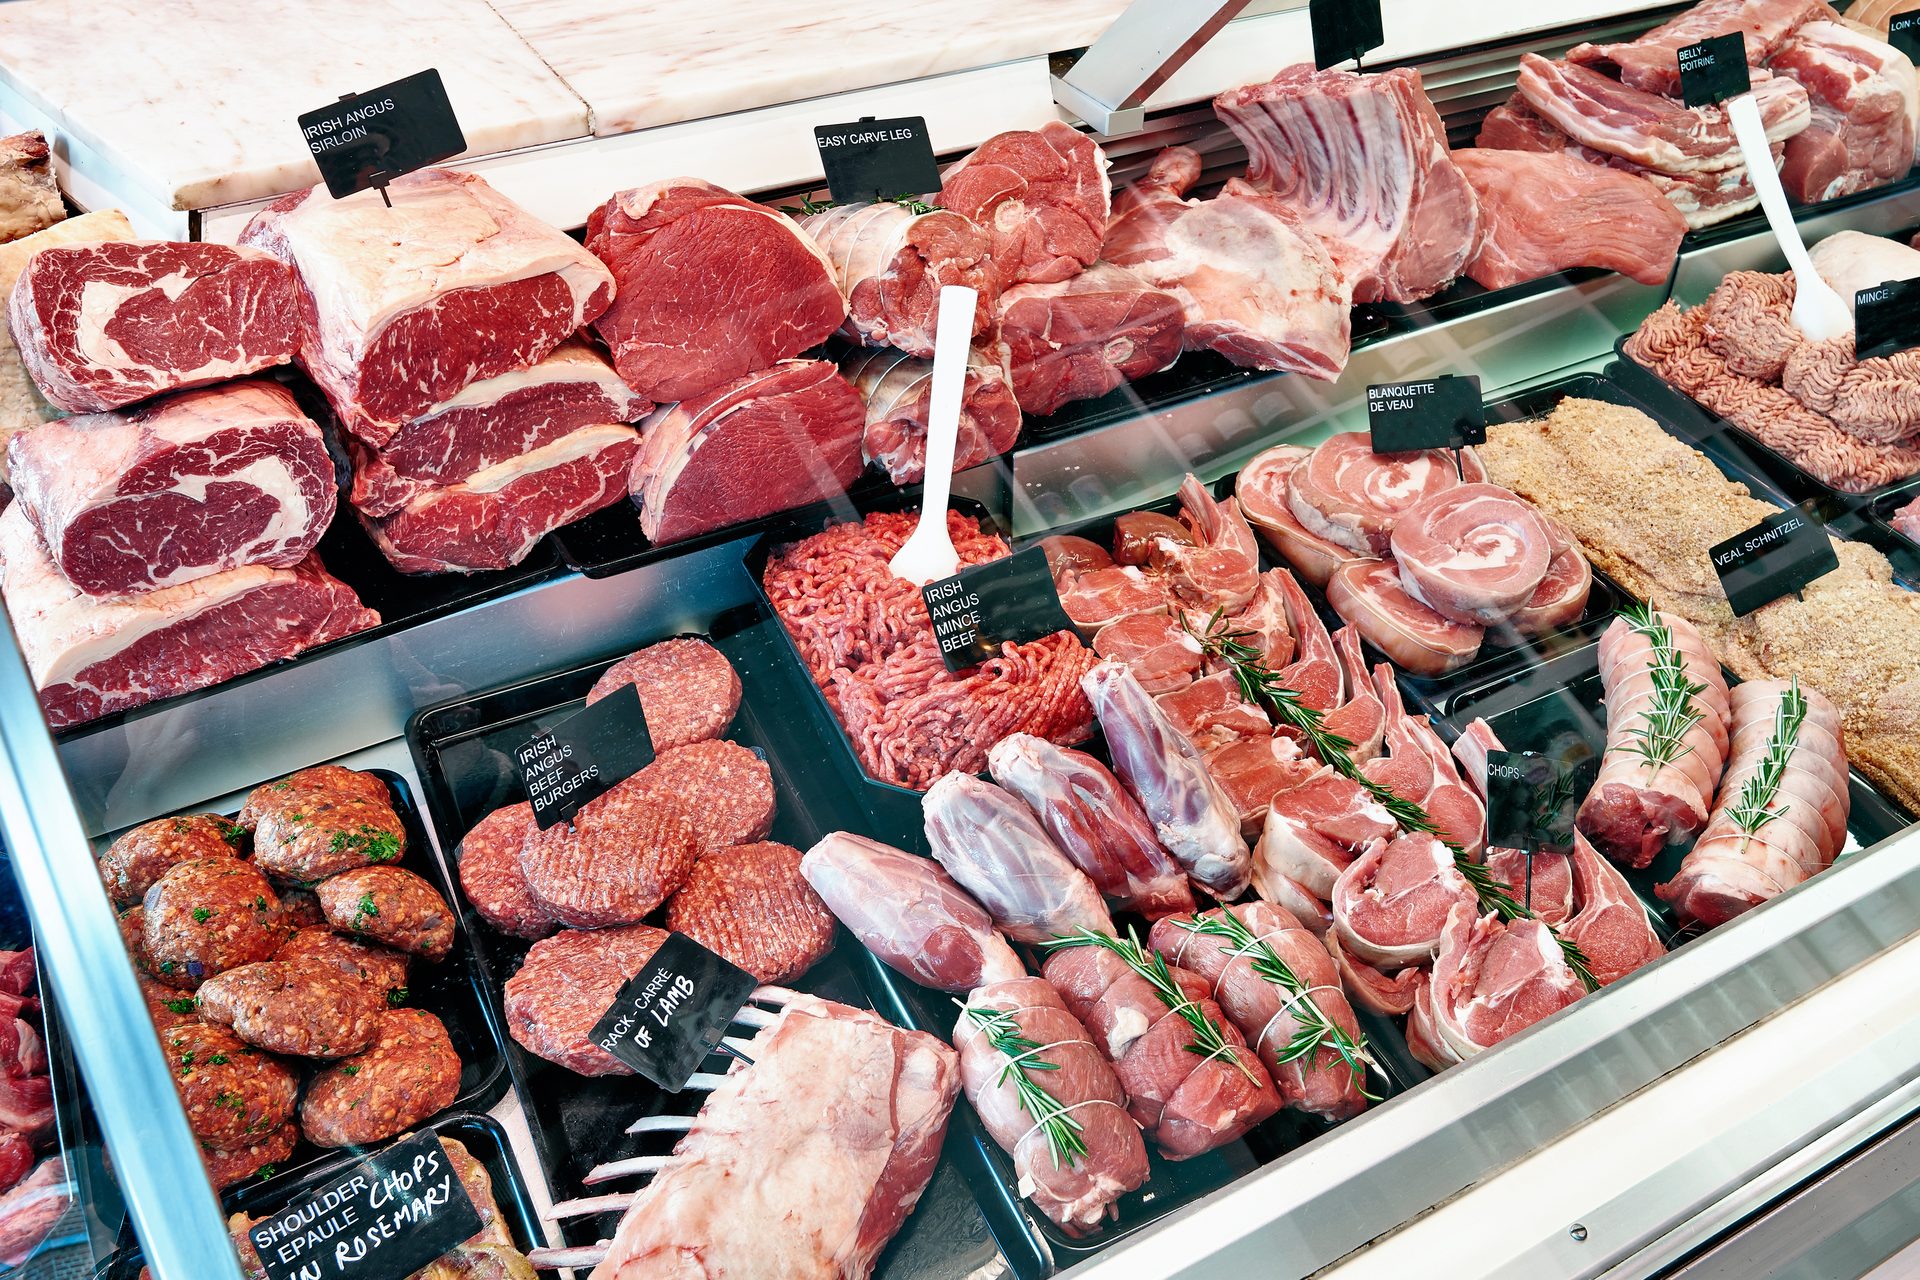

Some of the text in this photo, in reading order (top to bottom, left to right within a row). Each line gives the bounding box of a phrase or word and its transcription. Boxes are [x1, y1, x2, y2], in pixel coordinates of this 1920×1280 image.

[1891, 20, 1910, 31] LOIN
[1679, 46, 1702, 61] BELLY
[1680, 55, 1715, 73] POITRINE
[303, 98, 395, 140] IRISH ANGUS
[310, 125, 367, 154] SIRLOIN
[817, 128, 912, 148] EASY CARVE LEG
[1857, 289, 1889, 305] MINCE
[1368, 383, 1435, 399] BLANQUETTE
[1370, 398, 1413, 412] DE VEAU
[1715, 517, 1804, 566] VEAL SCHNITZEL
[926, 580, 963, 604] IRISH
[933, 593, 980, 620] ANGUS
[936, 610, 981, 637] MINCE
[942, 629, 976, 653] BEEF
[520, 735, 557, 765] IRISH
[526, 744, 573, 781] ANGUS
[529, 766, 564, 796] BEEF
[1487, 763, 1520, 780] CHOPS
[534, 764, 599, 812] BURGERS
[634, 975, 694, 1048] OF LAMB
[600, 1014, 635, 1052] RACK
[255, 1150, 439, 1249] SHOULDER CHOPS
[277, 1205, 360, 1265] EPAULE
[335, 1174, 450, 1271] ROSEMARY
